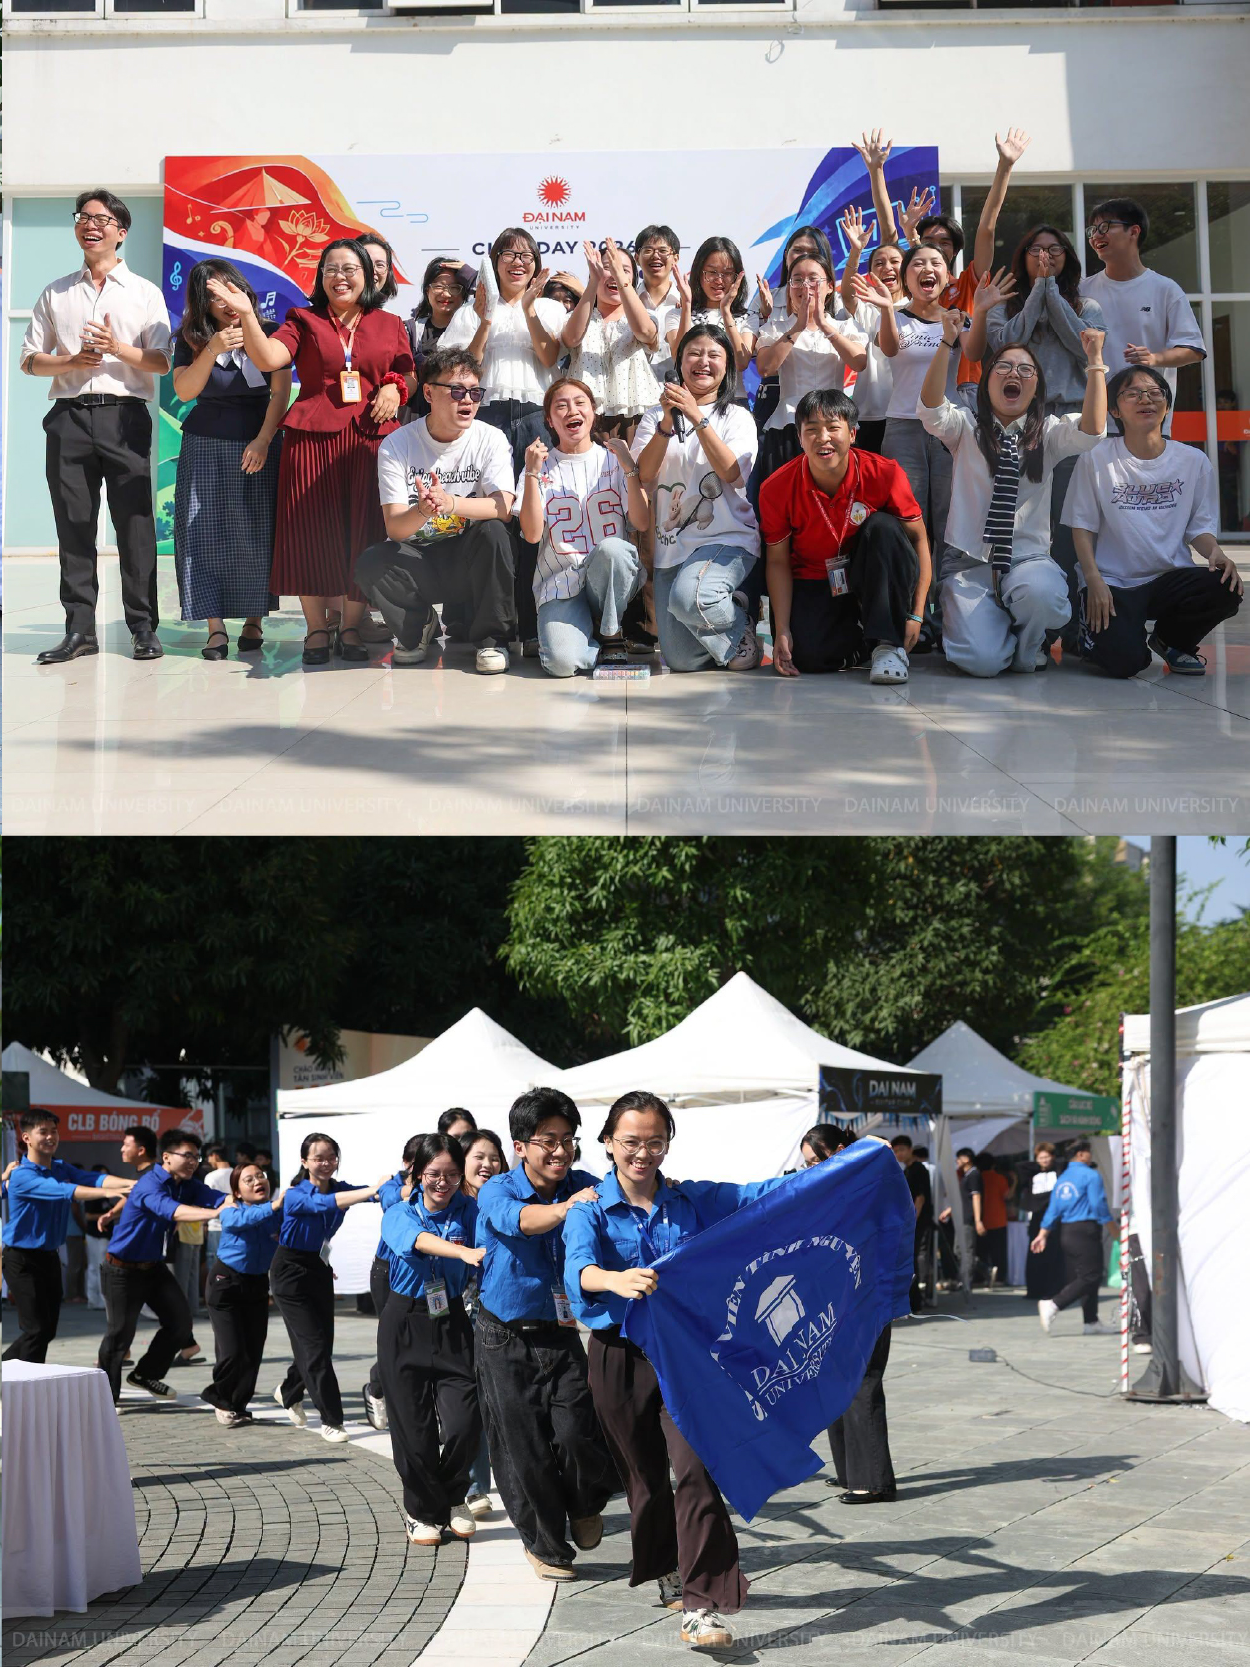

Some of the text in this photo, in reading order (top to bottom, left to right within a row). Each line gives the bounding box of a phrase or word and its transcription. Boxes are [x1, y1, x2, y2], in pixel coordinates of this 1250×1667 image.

[551, 212, 586, 222] NAM
[537, 241, 579, 254] DAY
[546, 488, 625, 555] 26
[891, 1080, 917, 1098] NAM
[68, 1113, 95, 1131] CLB
[98, 1110, 138, 1131] BÓNG
